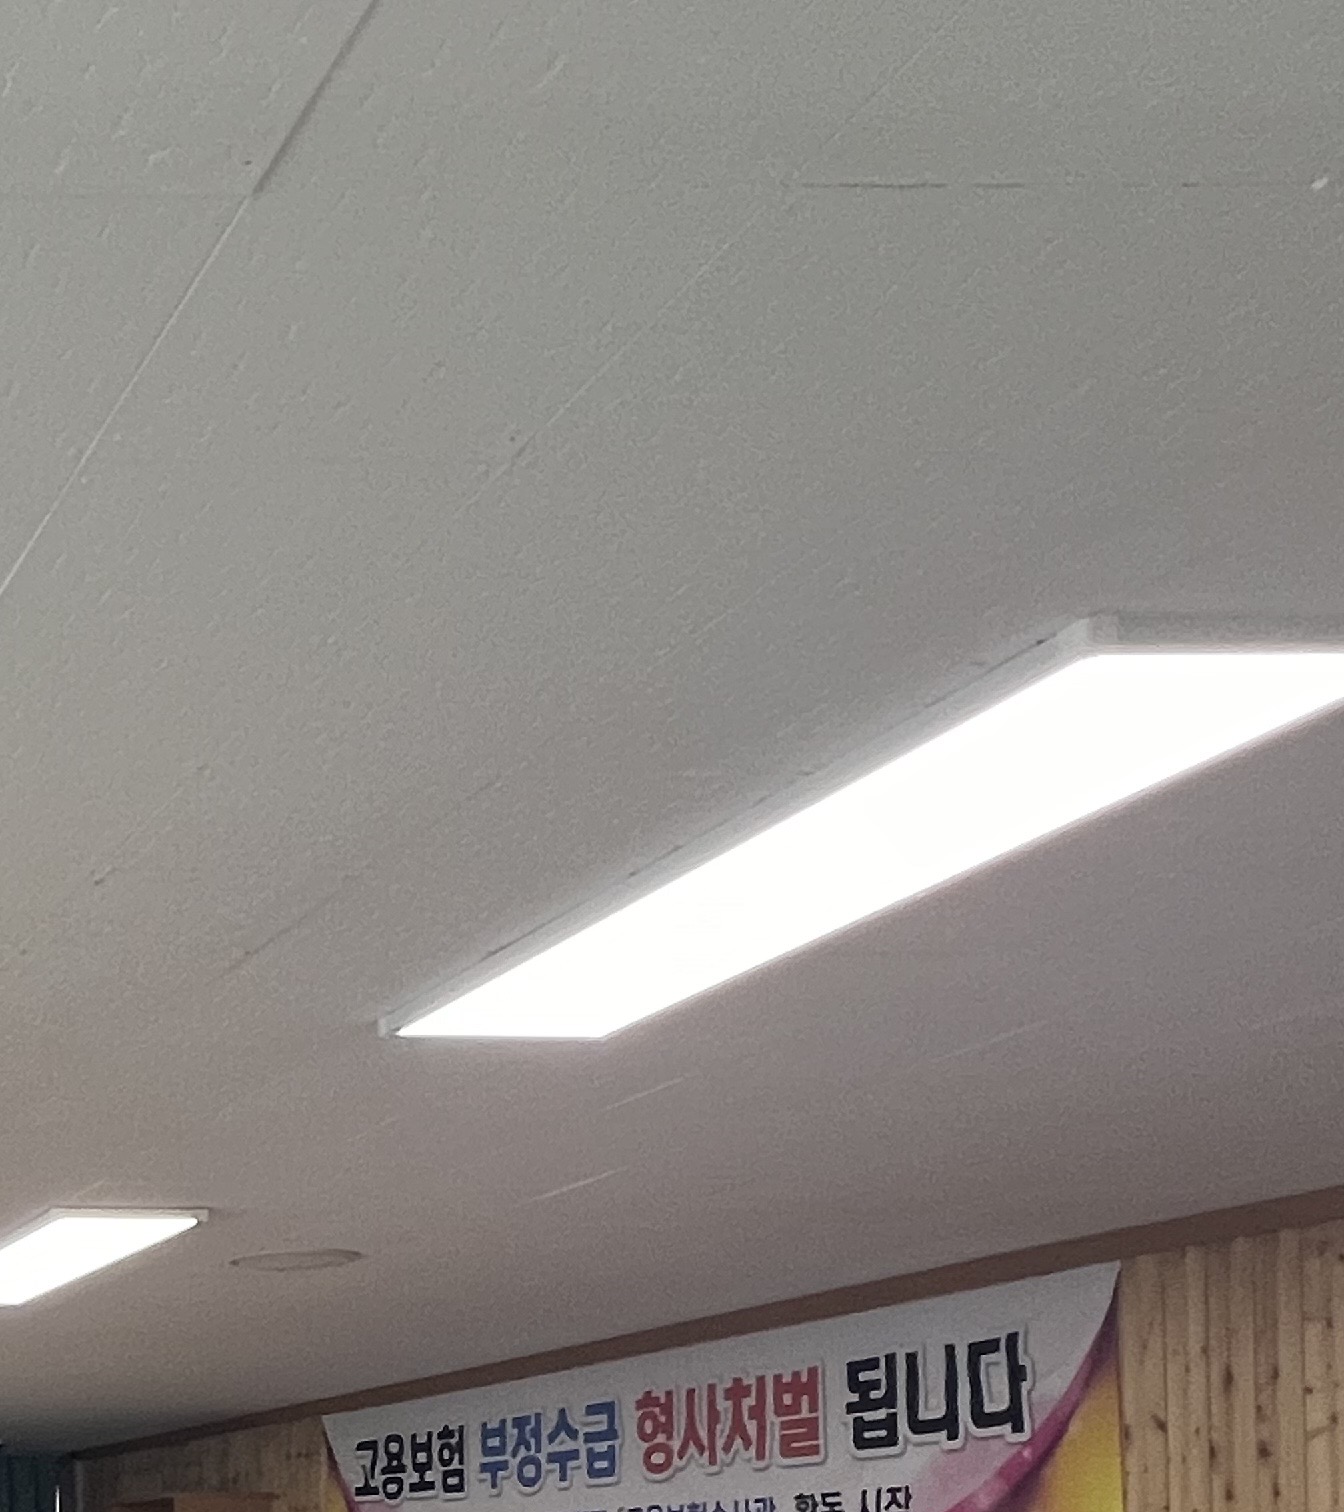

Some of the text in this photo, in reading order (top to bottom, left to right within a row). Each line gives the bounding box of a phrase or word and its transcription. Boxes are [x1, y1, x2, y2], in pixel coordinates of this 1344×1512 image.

[355, 1331, 1028, 1500] 고용보험 부정수급 형사처벌 됩니다
